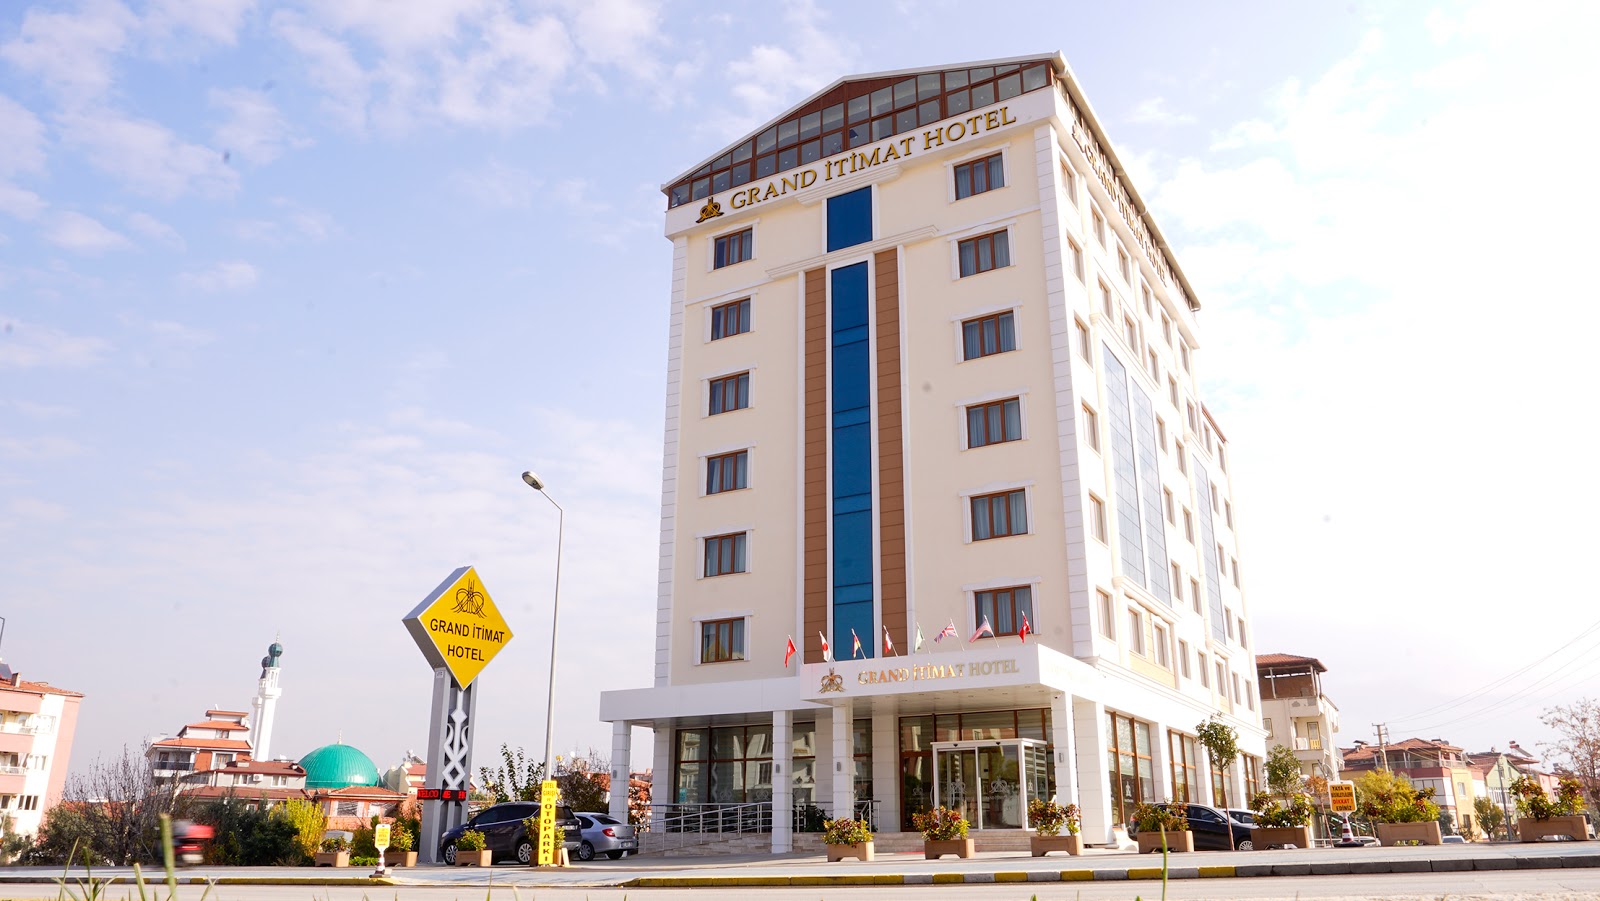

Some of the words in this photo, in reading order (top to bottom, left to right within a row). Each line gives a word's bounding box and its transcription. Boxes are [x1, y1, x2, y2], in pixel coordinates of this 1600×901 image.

[729, 167, 818, 210] GRAND
[824, 135, 916, 181] İTİMAT
[922, 105, 1017, 151] HOTEL
[430, 618, 470, 637] GRAND
[472, 623, 505, 643] İTİMAT
[447, 644, 485, 662] HOTEL
[857, 667, 910, 685] GRAND
[912, 662, 965, 681] İTİMAT
[968, 659, 1019, 677] HOTEL
